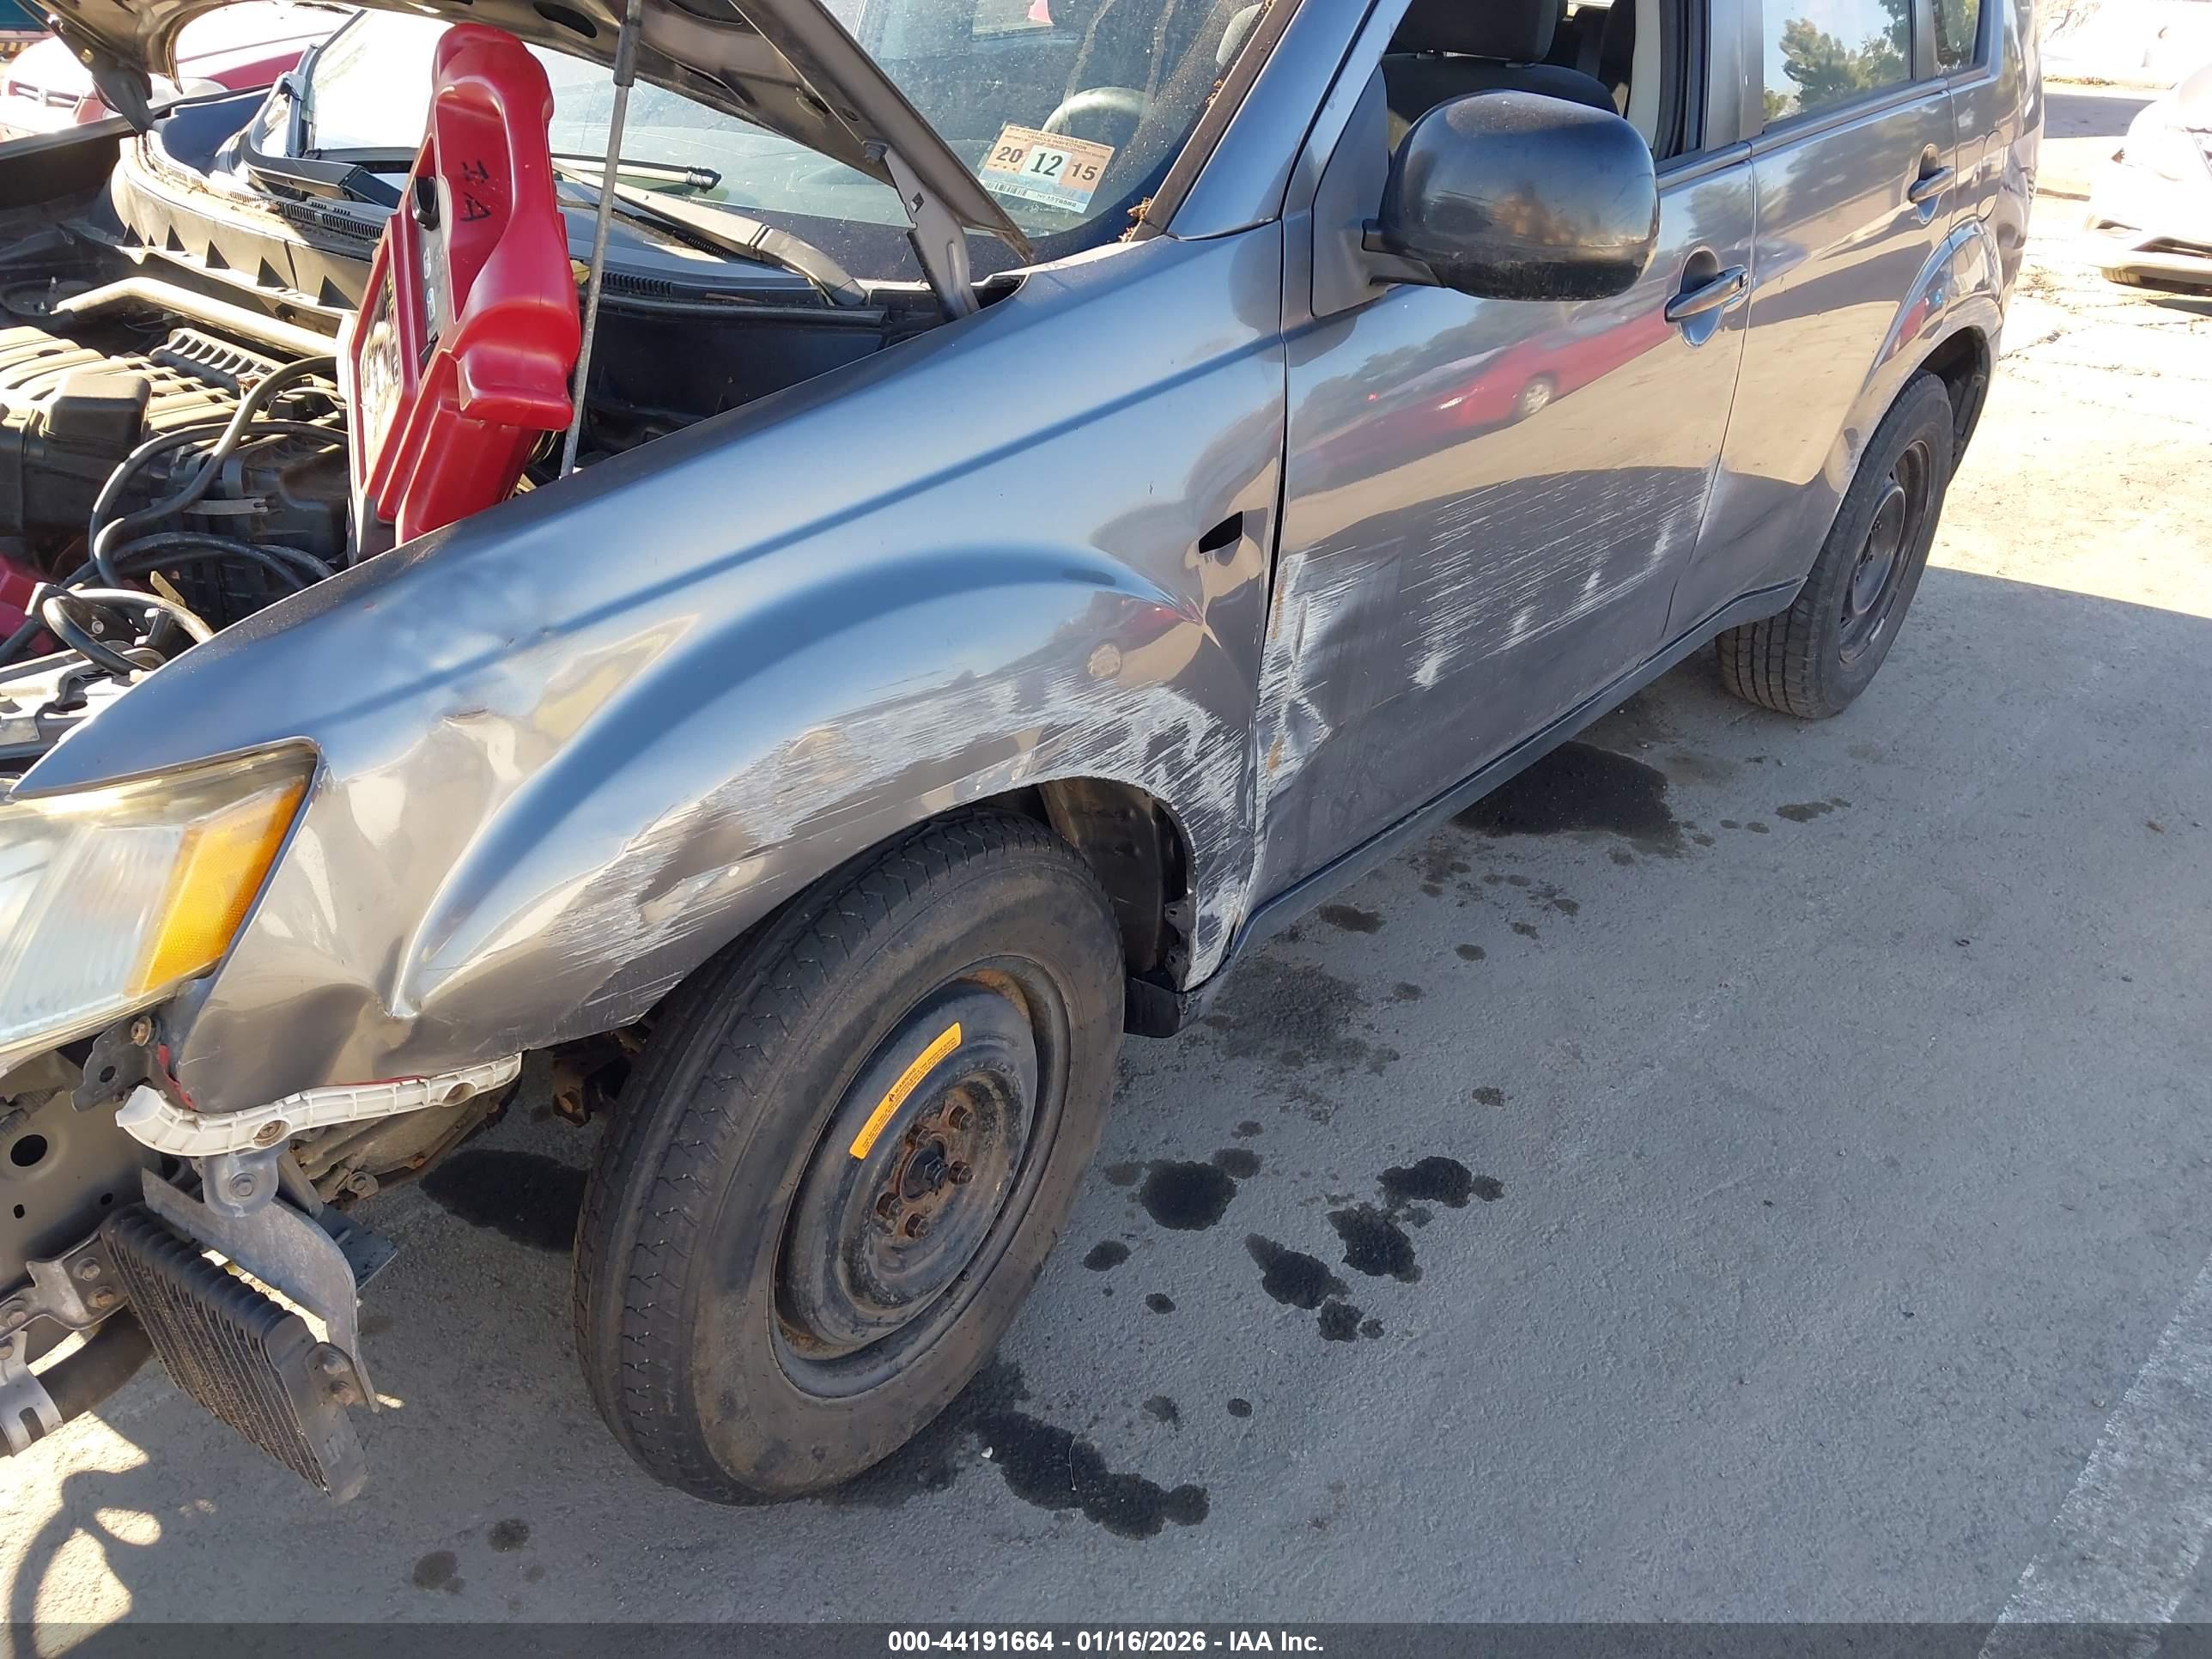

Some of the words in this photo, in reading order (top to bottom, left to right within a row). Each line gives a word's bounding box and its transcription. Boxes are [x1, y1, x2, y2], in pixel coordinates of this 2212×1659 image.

[1028, 134, 1052, 143] VEHICLE
[1052, 139, 1088, 151] INSPECTION
[996, 146, 1024, 163] 20
[1030, 152, 1064, 177] 12
[1072, 163, 1098, 181] 15
[894, 1066, 916, 1094] WARNING
